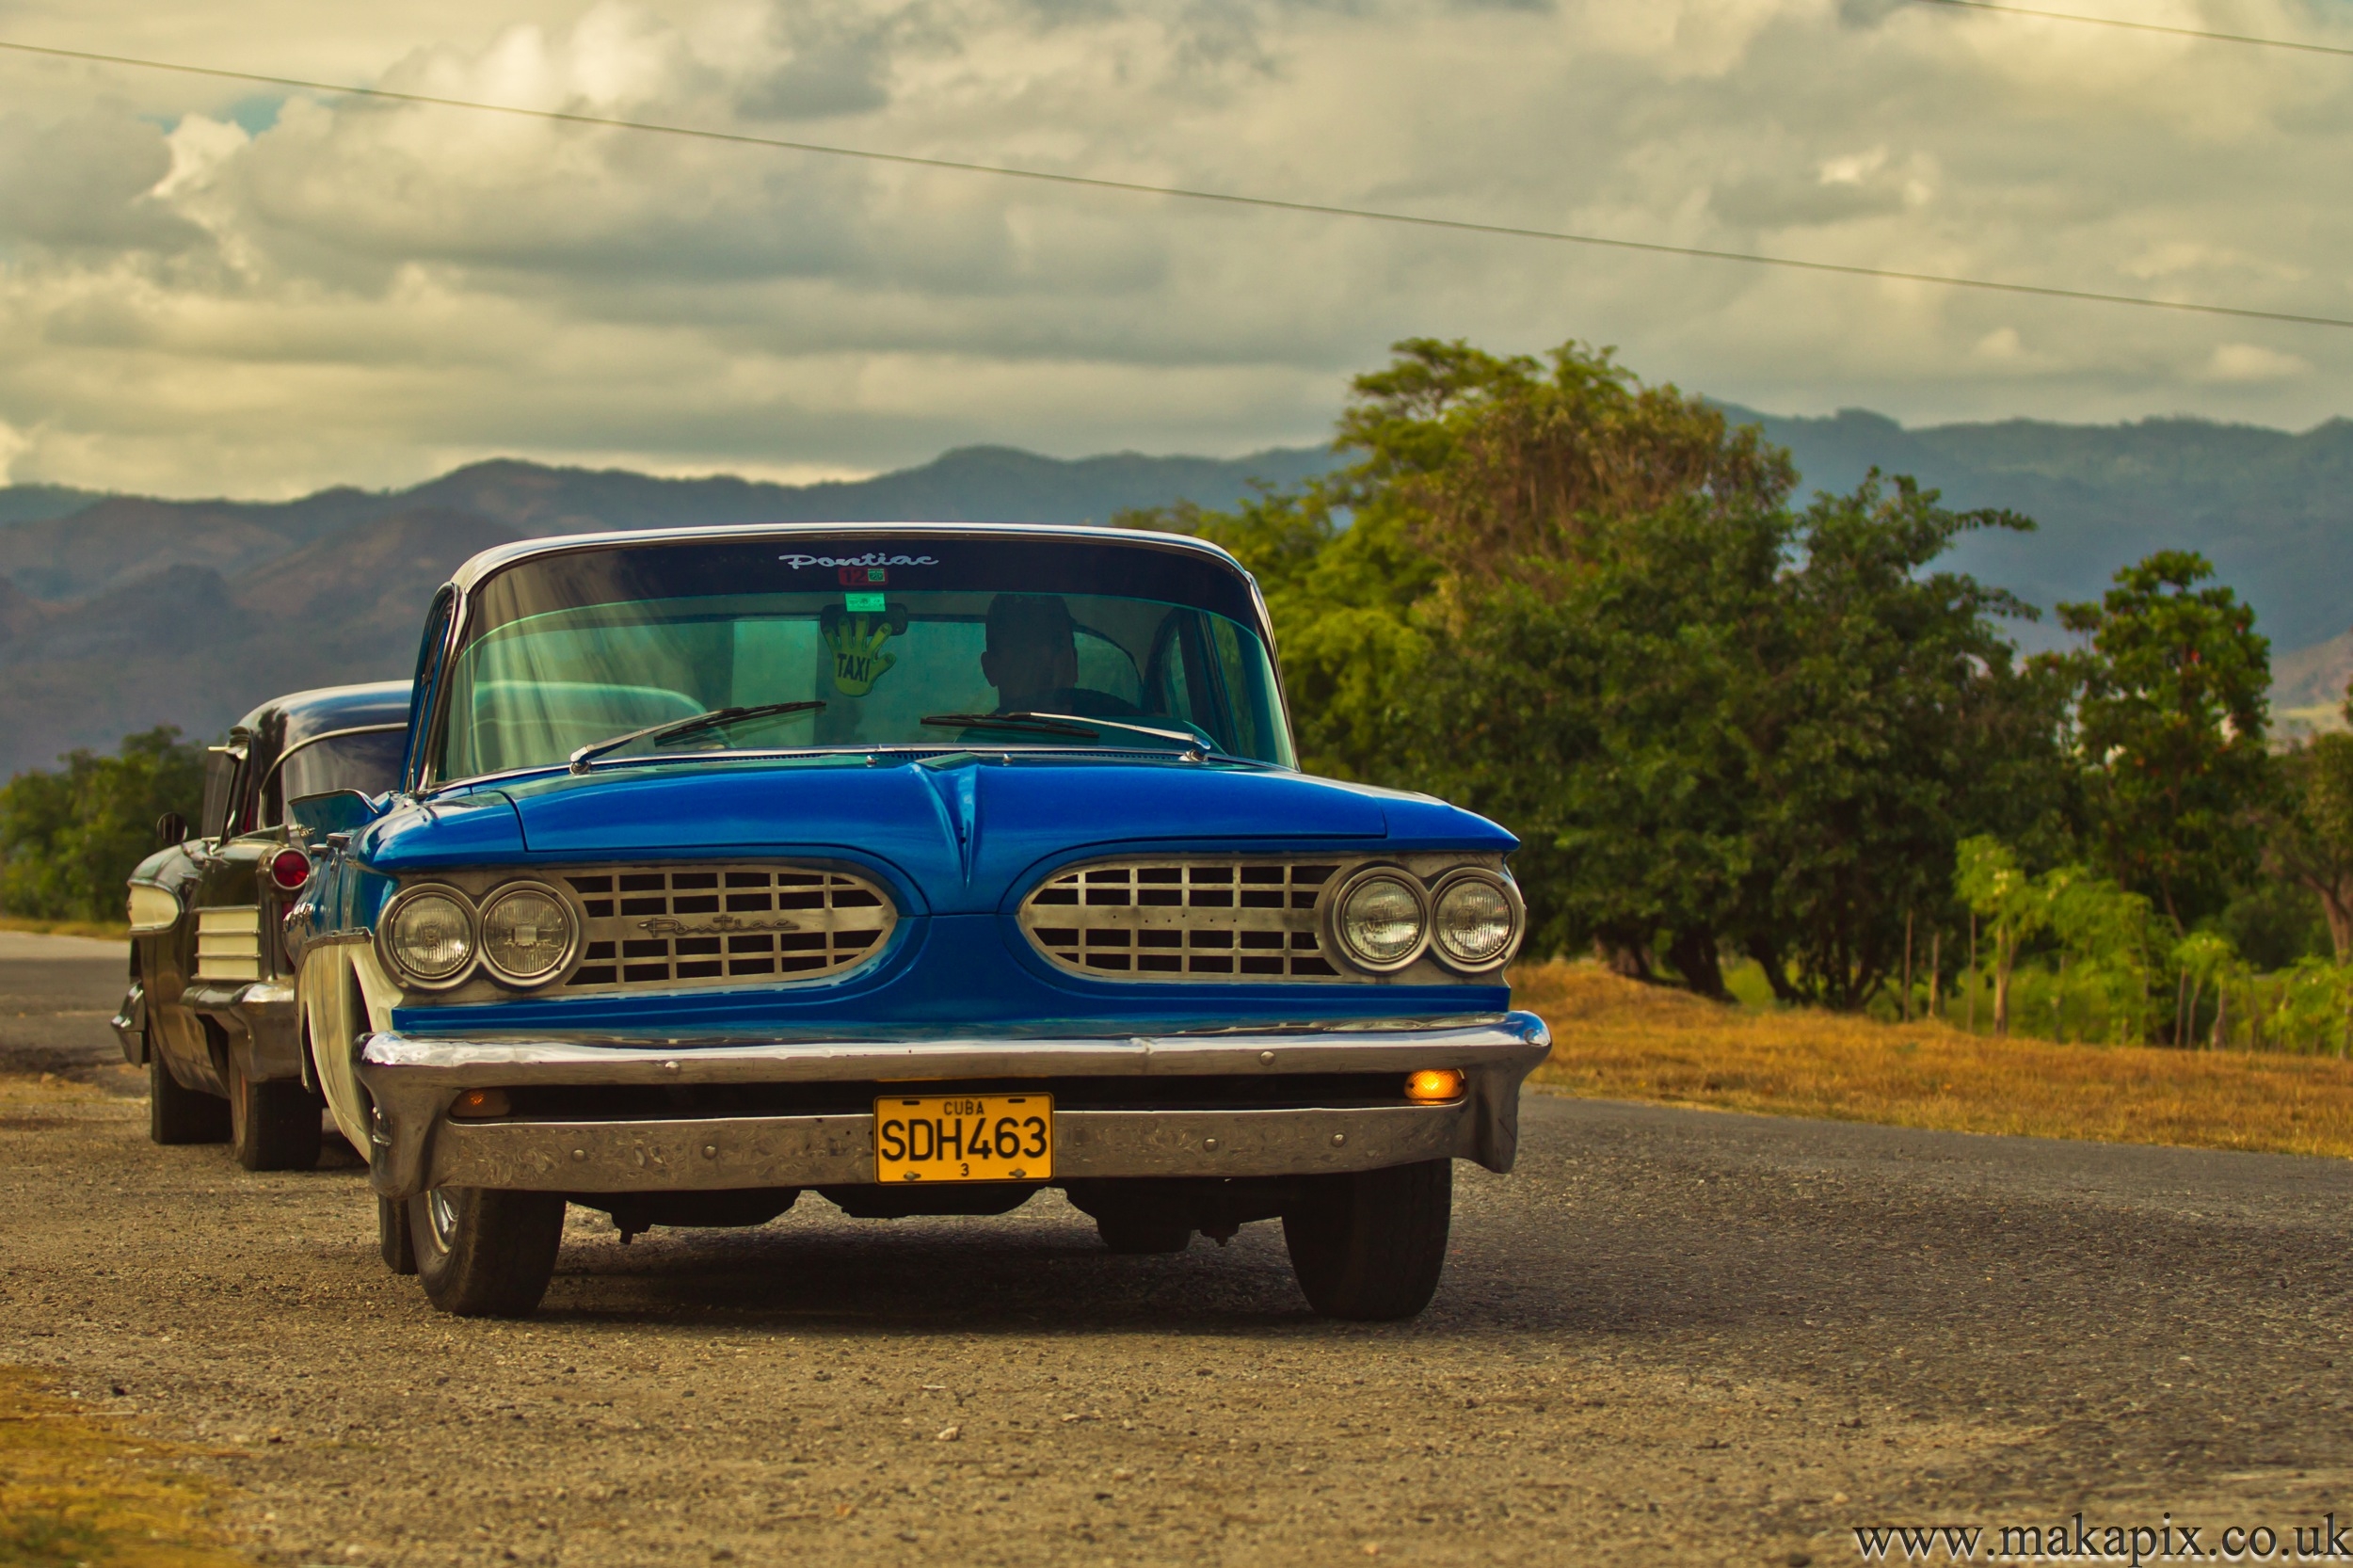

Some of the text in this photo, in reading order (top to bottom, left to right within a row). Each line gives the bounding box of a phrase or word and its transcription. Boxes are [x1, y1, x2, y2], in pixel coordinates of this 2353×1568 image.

[778, 552, 939, 569] Pontiac
[837, 653, 871, 682] TAXI
[637, 914, 800, 937] Pontiac
[944, 1100, 984, 1115] CUBA
[881, 1116, 1047, 1161] SDH463
[960, 1162, 969, 1176] 3
